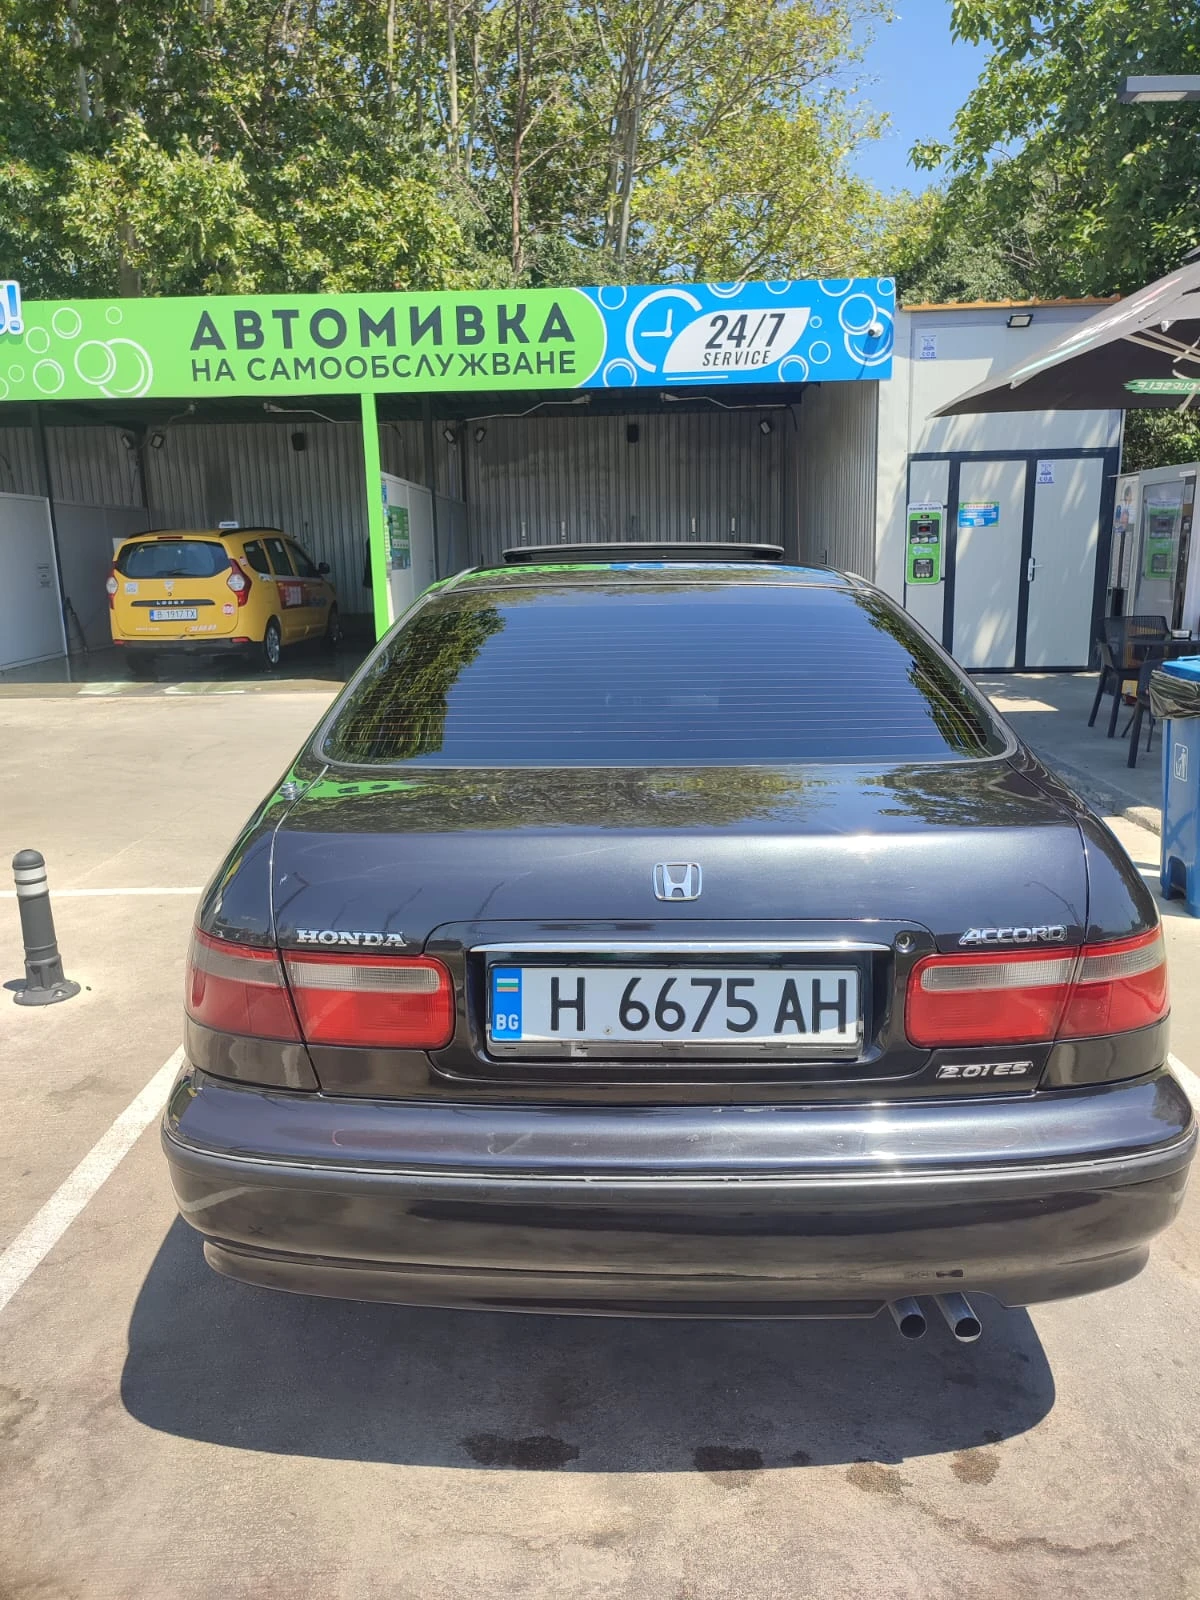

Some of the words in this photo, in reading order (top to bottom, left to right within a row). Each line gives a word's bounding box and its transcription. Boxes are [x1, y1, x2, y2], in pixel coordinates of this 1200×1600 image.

[190, 302, 576, 351] АВТОМИВКА
[704, 312, 786, 350] 24/7
[191, 358, 237, 382] НА
[246, 350, 577, 381] САМООБСЛУЖВАНЕ
[702, 350, 771, 367] SERVICE
[295, 929, 408, 947] HONDA
[959, 924, 1068, 946] ACCORD
[550, 976, 586, 1032] H
[618, 977, 759, 1033] 6675
[773, 978, 848, 1034] AH
[495, 1013, 520, 1031] BG
